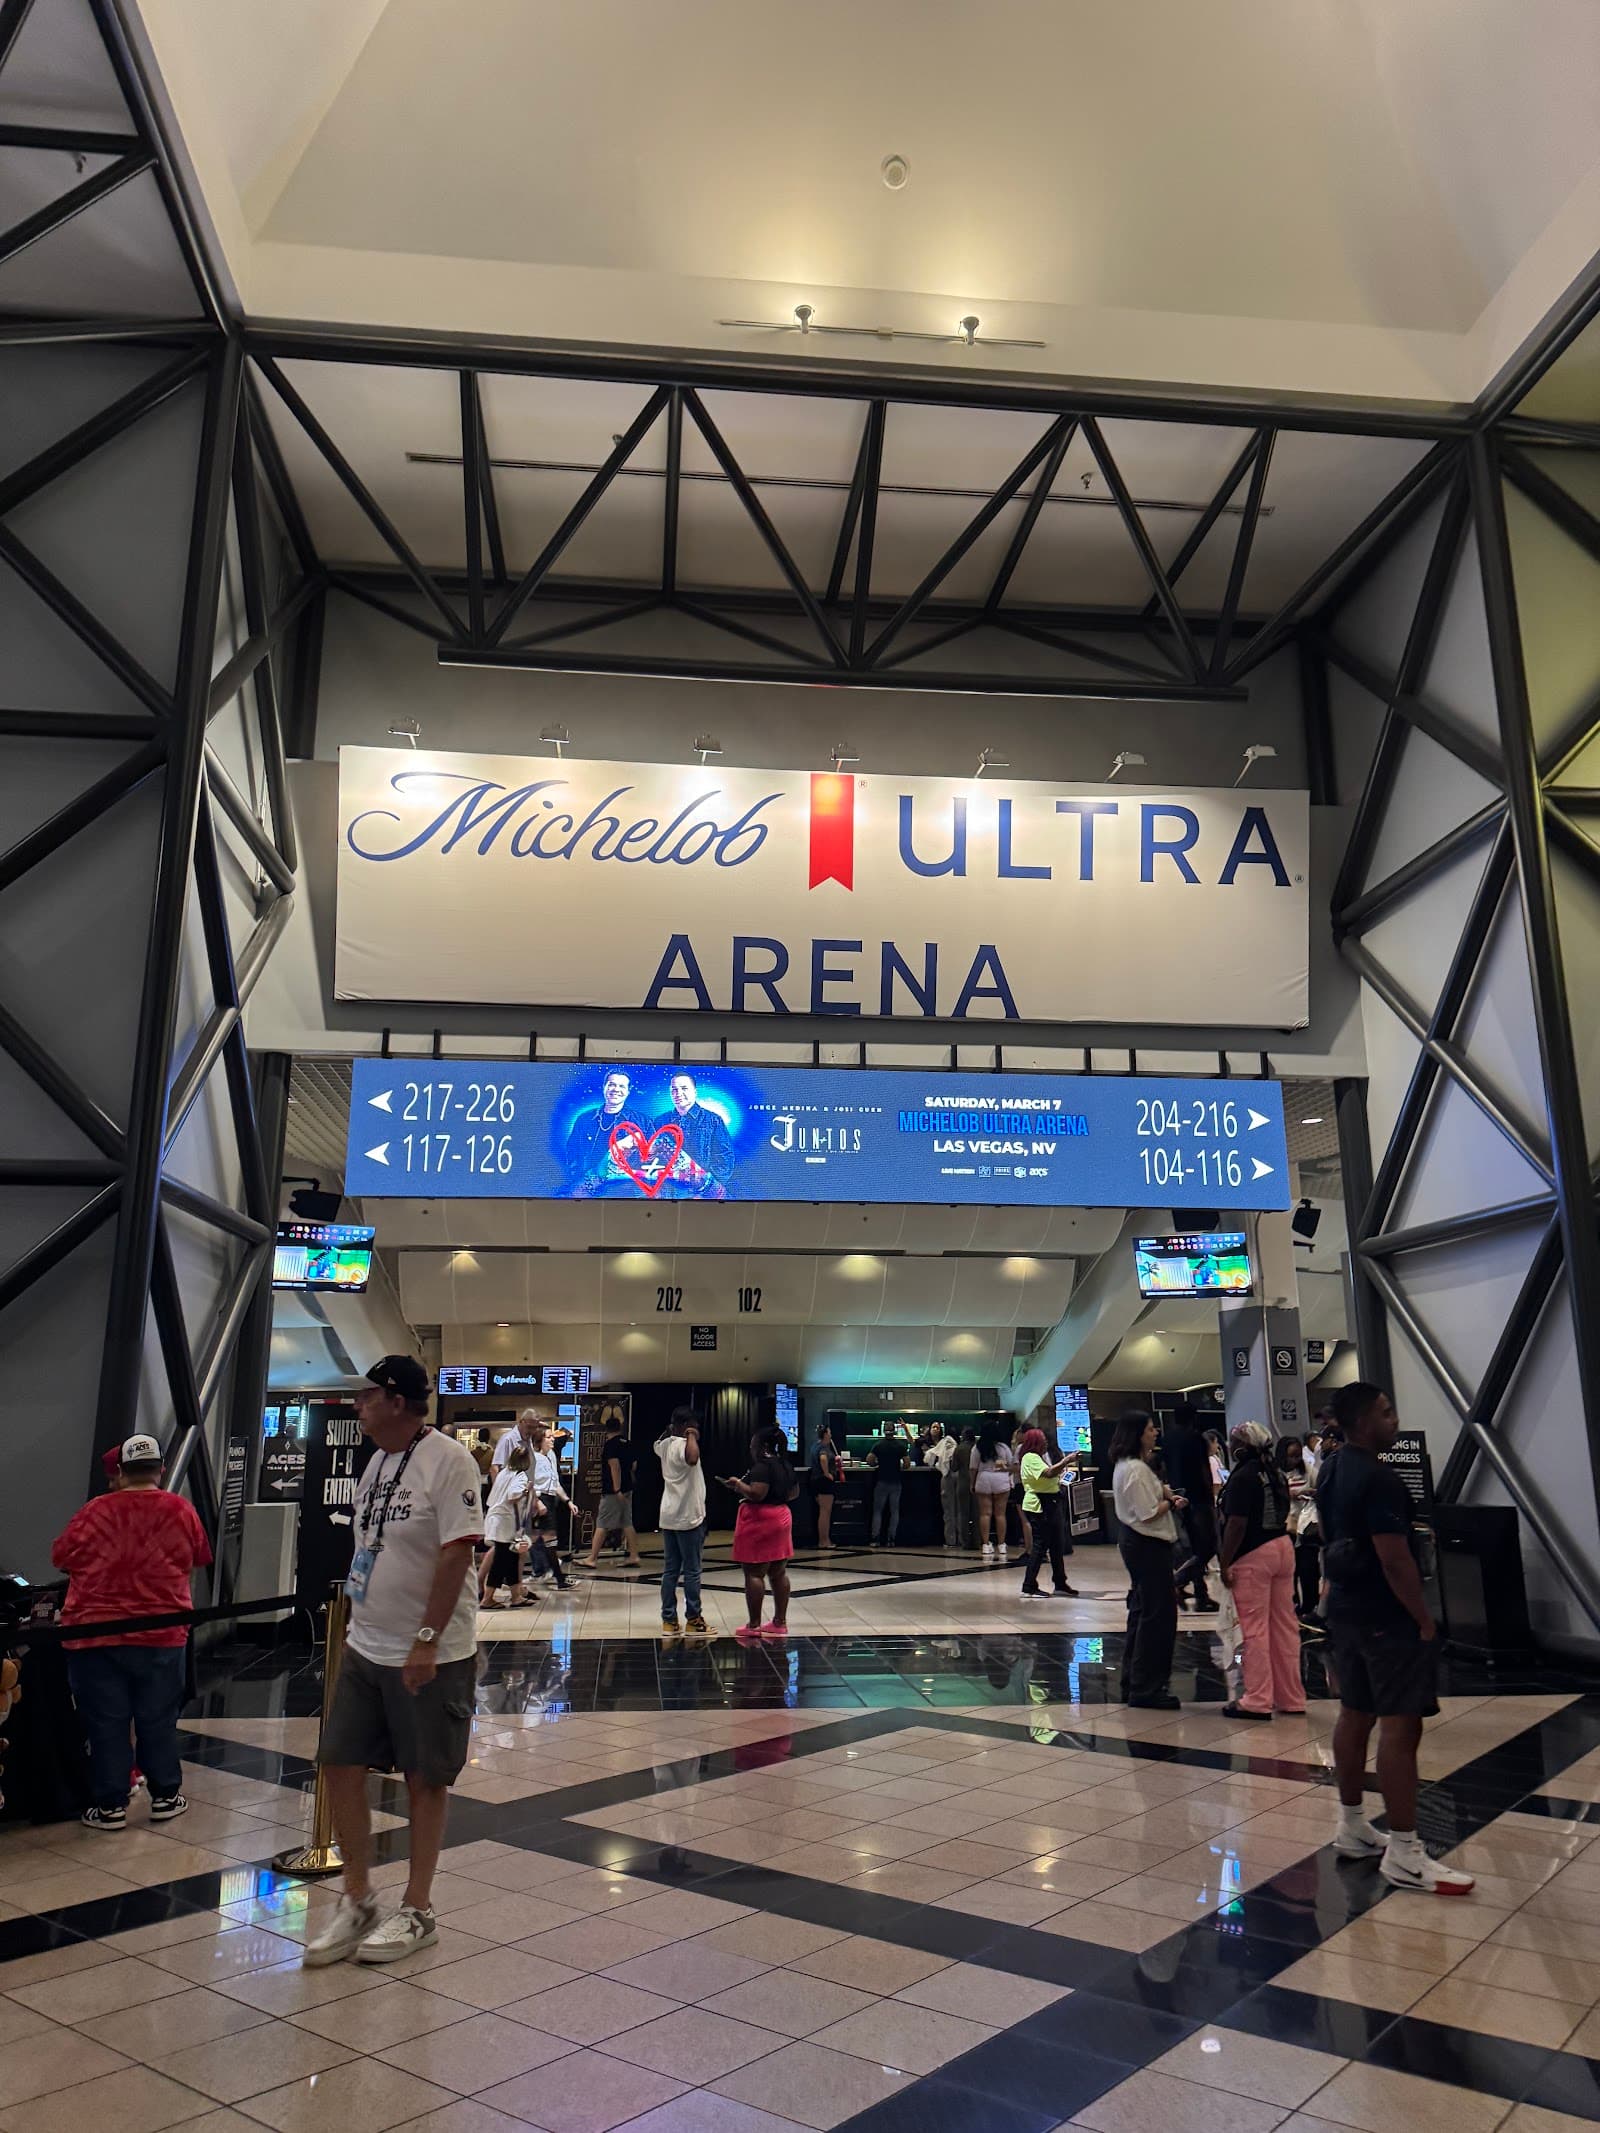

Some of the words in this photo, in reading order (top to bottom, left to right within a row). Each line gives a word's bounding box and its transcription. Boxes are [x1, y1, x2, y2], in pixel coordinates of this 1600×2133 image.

[347, 771, 785, 867] Michelob
[899, 795, 1291, 887] ULTRA
[642, 934, 1020, 1020] ARENA
[402, 1082, 515, 1123] 217-226
[925, 1097, 999, 1111] SATURDAY,
[1002, 1098, 1050, 1110] MARCH
[1053, 1099, 1062, 1111] 7
[899, 1111, 981, 1134] MICHELOB
[983, 1113, 1032, 1135] ULTRA
[1035, 1115, 1089, 1136] ARENA
[1136, 1099, 1239, 1139] 204-216
[402, 1134, 513, 1174] 117-126
[933, 1139, 965, 1153] LAS
[968, 1141, 1028, 1156] VEGAS,
[1032, 1142, 1057, 1155] NV
[1140, 1148, 1242, 1187] 104-116
[656, 1287, 683, 1312] 202
[738, 1287, 762, 1312] 102
[326, 1420, 362, 1446] SUITES
[1410, 1440, 1420, 1450] IN
[267, 1454, 306, 1464] ACES
[1377, 1452, 1421, 1464] PROGRESS
[323, 1477, 358, 1505] ENTRY
